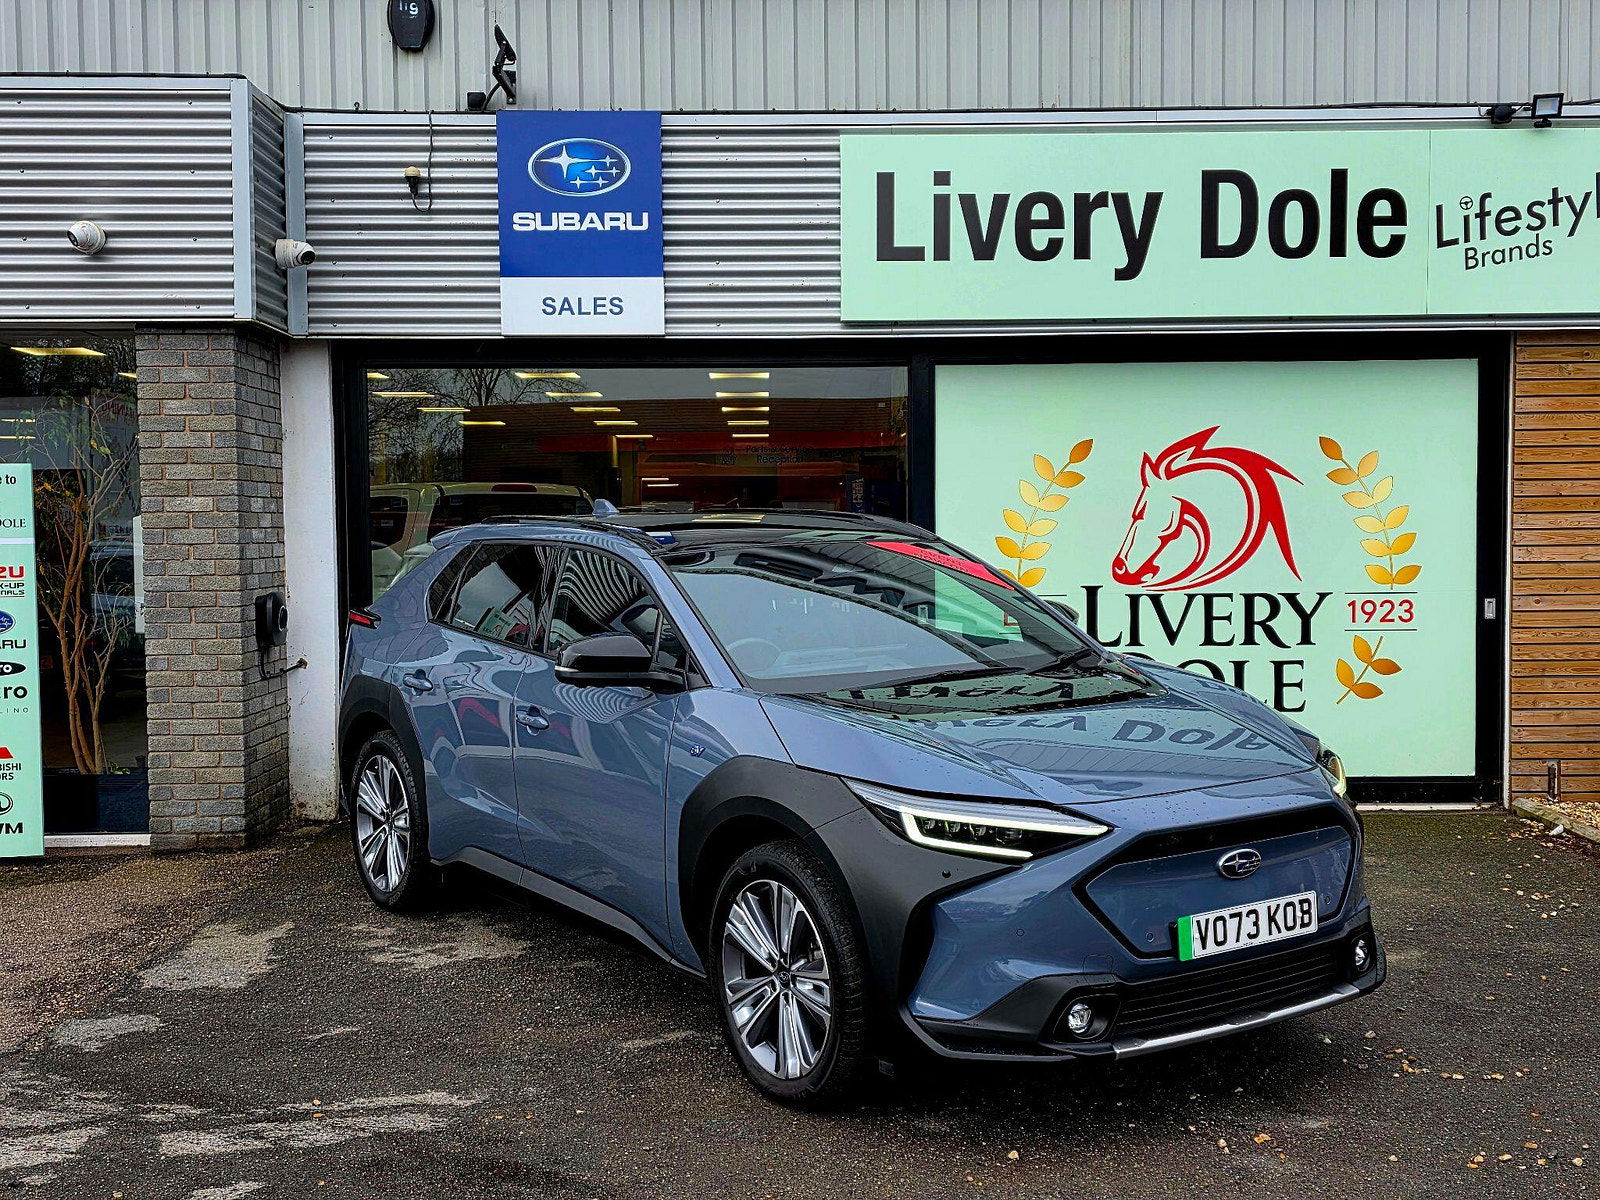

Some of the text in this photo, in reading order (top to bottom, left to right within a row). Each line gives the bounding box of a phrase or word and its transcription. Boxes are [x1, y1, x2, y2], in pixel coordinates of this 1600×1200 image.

[512, 212, 649, 231] SUBARU
[876, 168, 1408, 281] Livery Dole
[1464, 233, 1553, 270] Brands
[541, 296, 624, 316] SALES
[5, 474, 17, 485] to
[0, 518, 26, 529] OLE
[1081, 585, 1333, 648] LIVERY
[1347, 599, 1415, 624] 1923
[0, 639, 27, 649] RU
[0, 686, 28, 700] ro
[0, 772, 14, 781] RS
[0, 822, 24, 834] M
[1195, 897, 1313, 950] VO73 KOB
